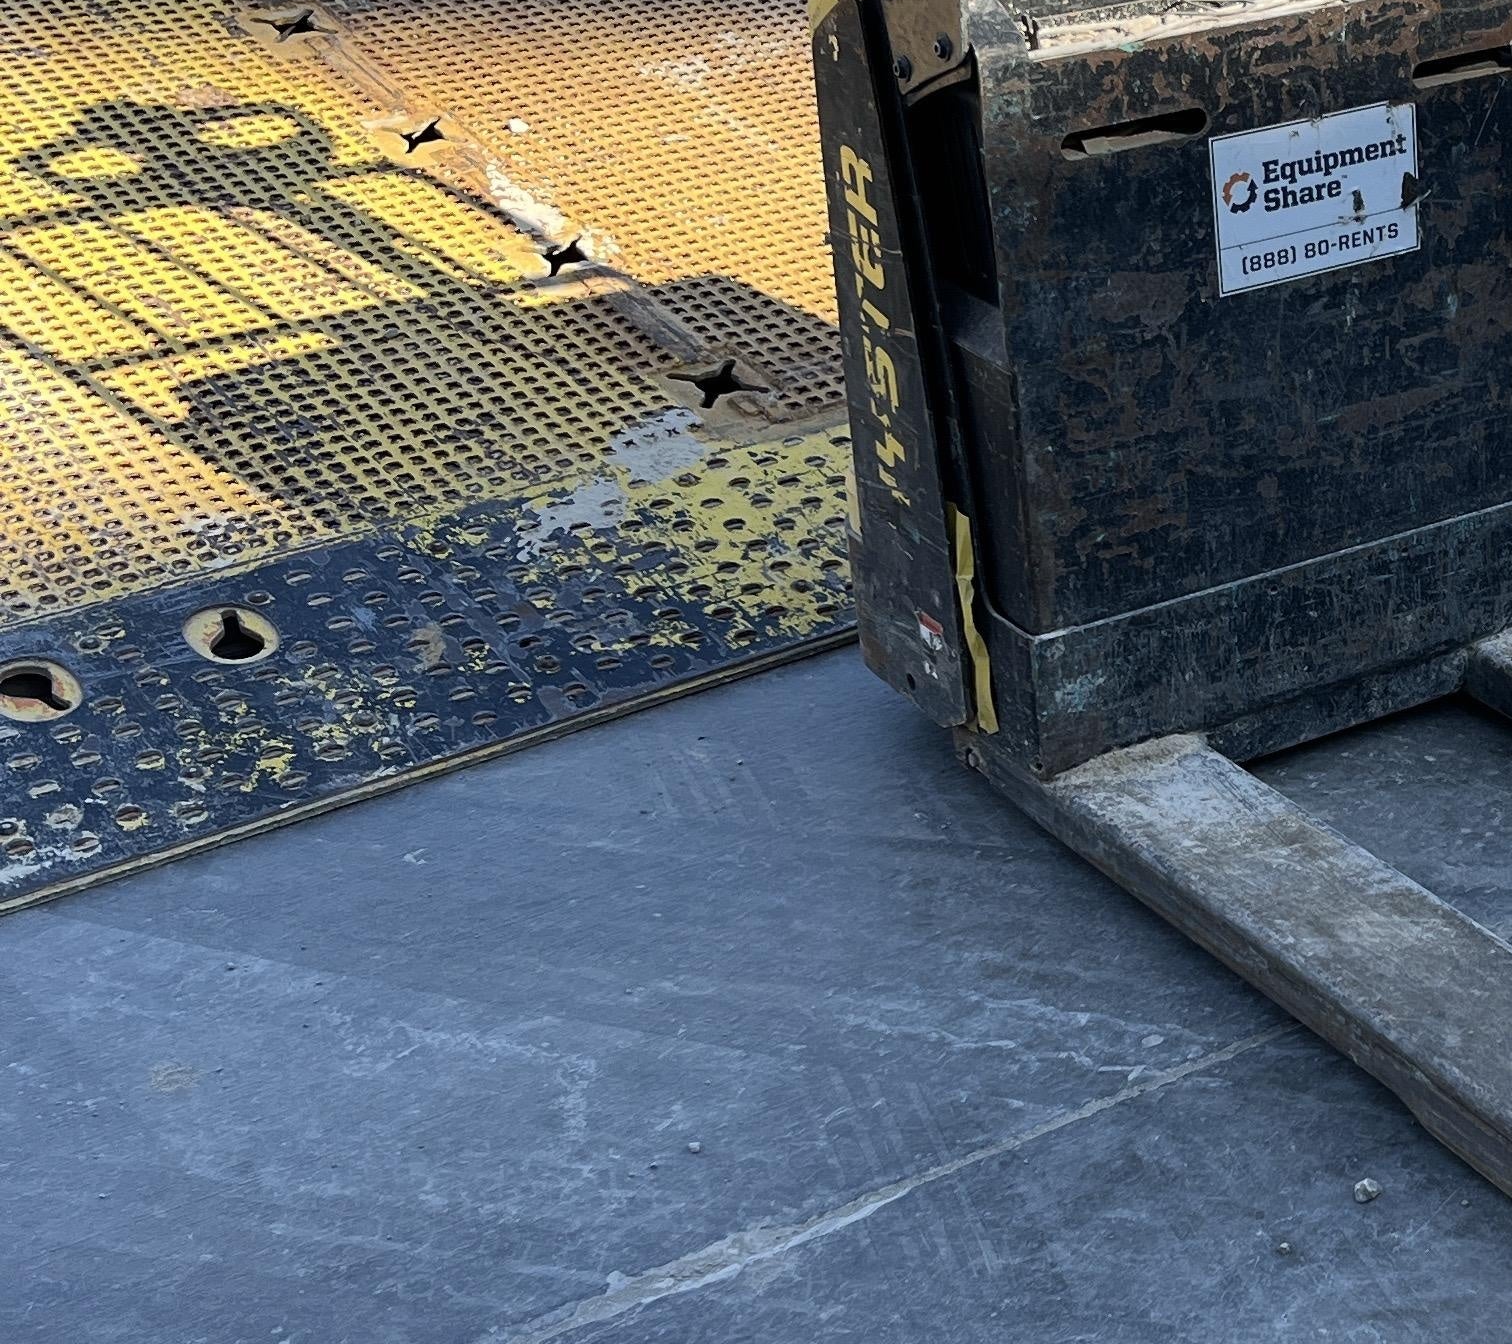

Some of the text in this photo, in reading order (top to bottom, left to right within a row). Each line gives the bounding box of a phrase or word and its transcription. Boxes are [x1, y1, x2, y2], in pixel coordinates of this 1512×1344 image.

[1262, 133, 1407, 185] Equipment
[1264, 179, 1342, 212] Share
[1242, 223, 1399, 275] (888) 80-RENTS
